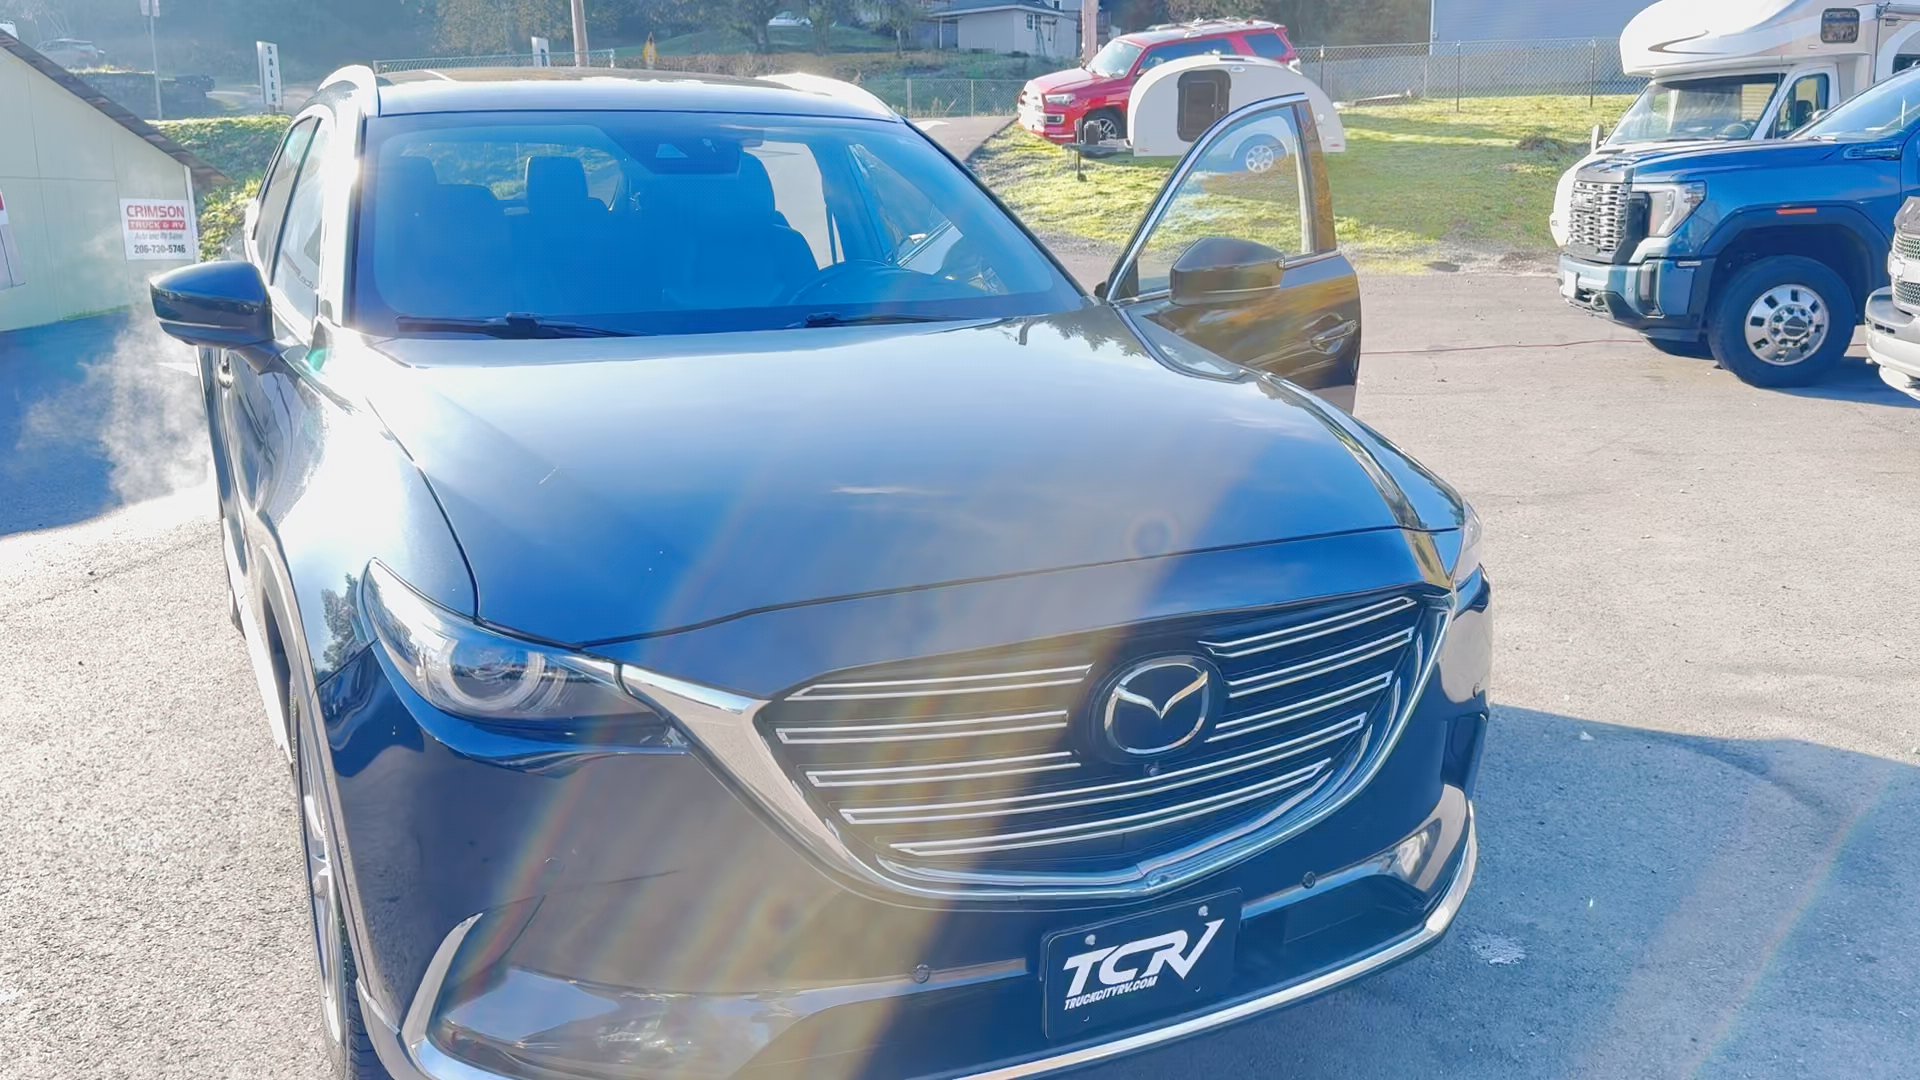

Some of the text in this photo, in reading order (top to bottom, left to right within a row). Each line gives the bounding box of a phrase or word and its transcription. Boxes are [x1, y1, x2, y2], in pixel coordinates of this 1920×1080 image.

[267, 46, 276, 102] SALES
[126, 204, 185, 218] CRIMSON
[130, 221, 160, 229] TRUCK
[134, 244, 186, 254] 206-730-5746
[1064, 975, 1158, 1011] TRUCKCITYRV.COM
